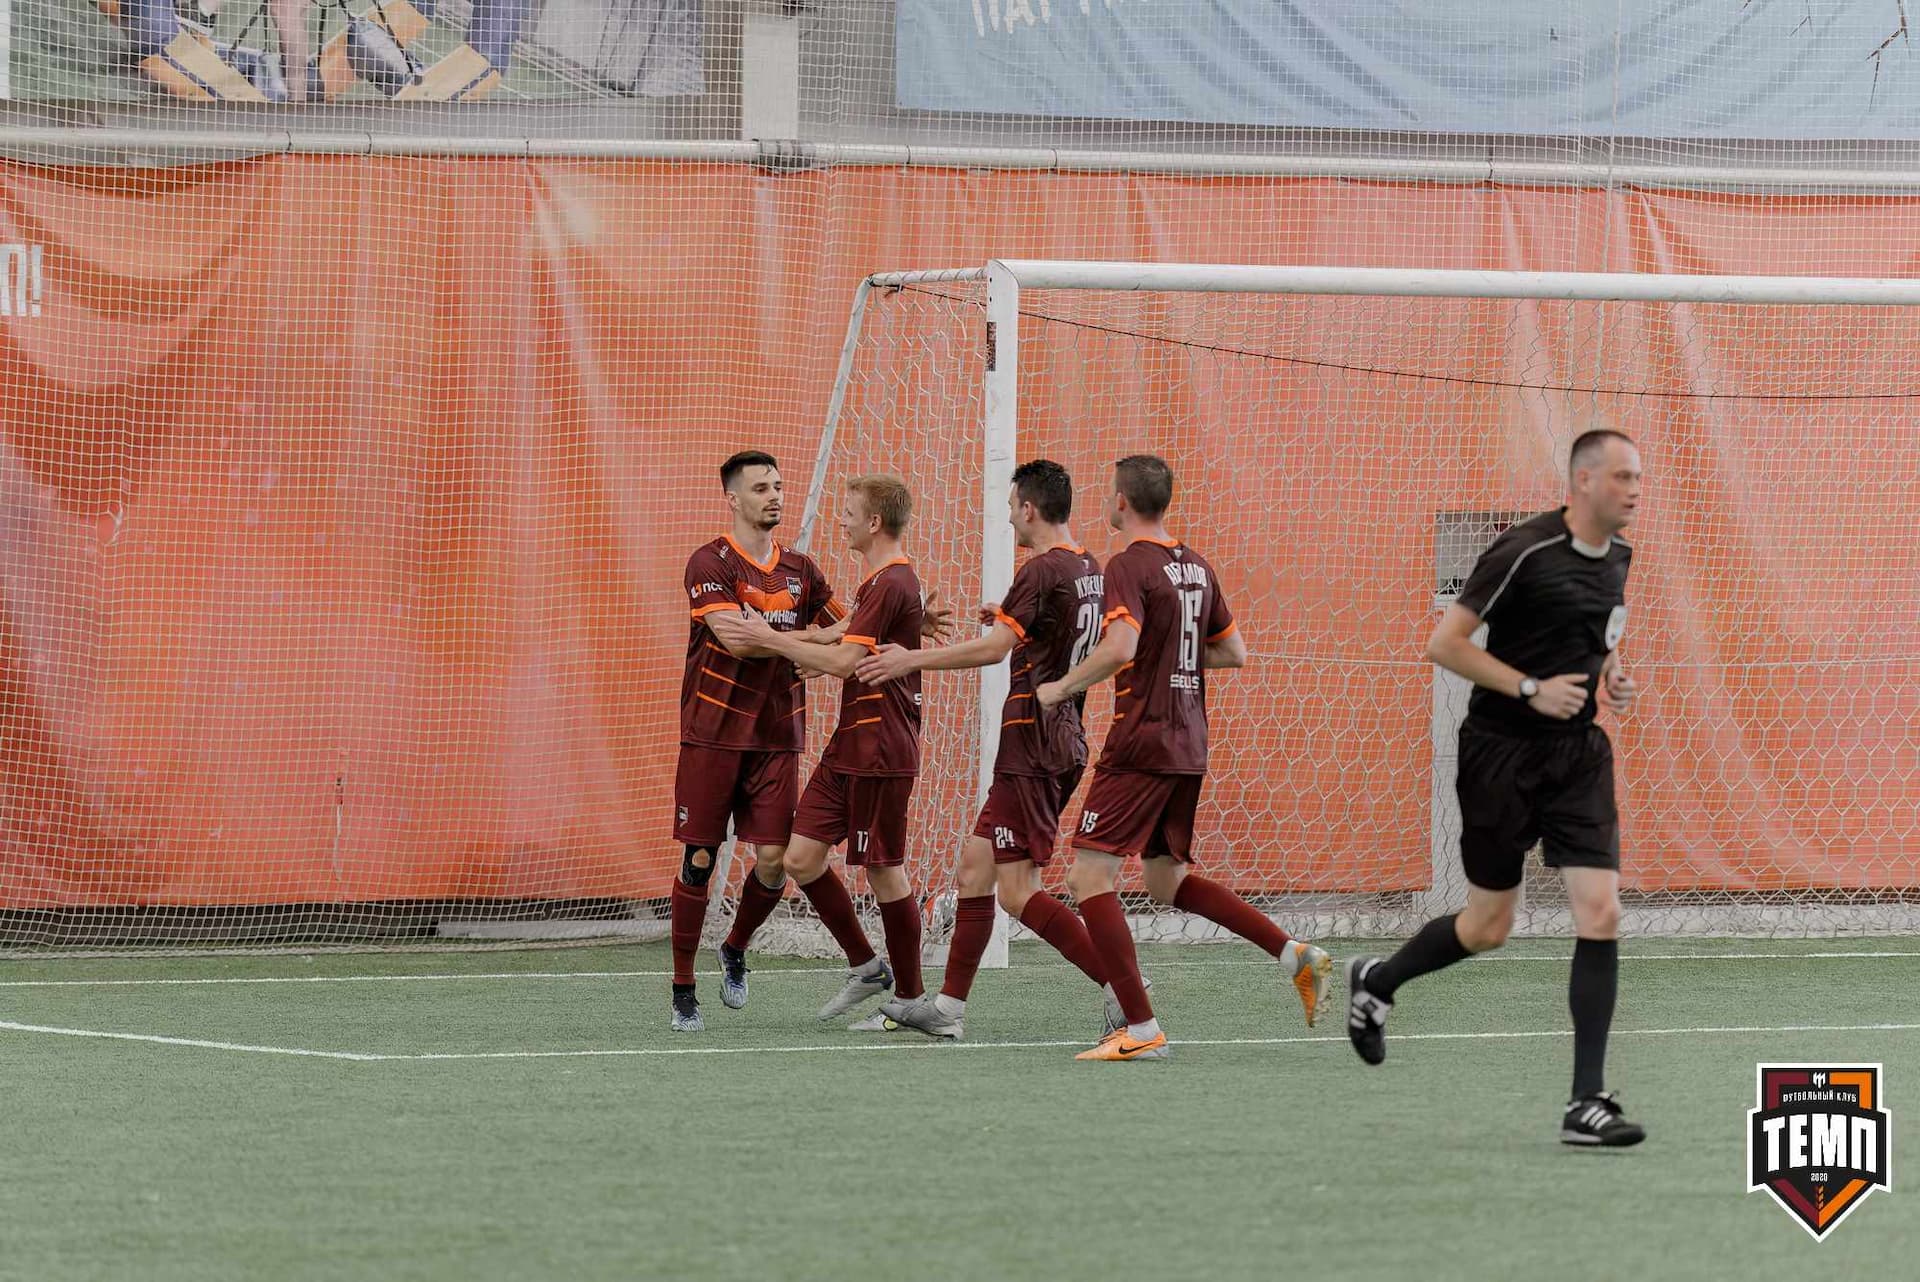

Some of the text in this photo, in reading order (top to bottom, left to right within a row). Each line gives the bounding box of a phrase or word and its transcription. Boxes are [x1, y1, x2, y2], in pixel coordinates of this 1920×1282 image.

[1178, 589, 1203, 671] 15
[1080, 810, 1099, 833] 15
[856, 830, 870, 853] 17
[994, 826, 1015, 849] 24
